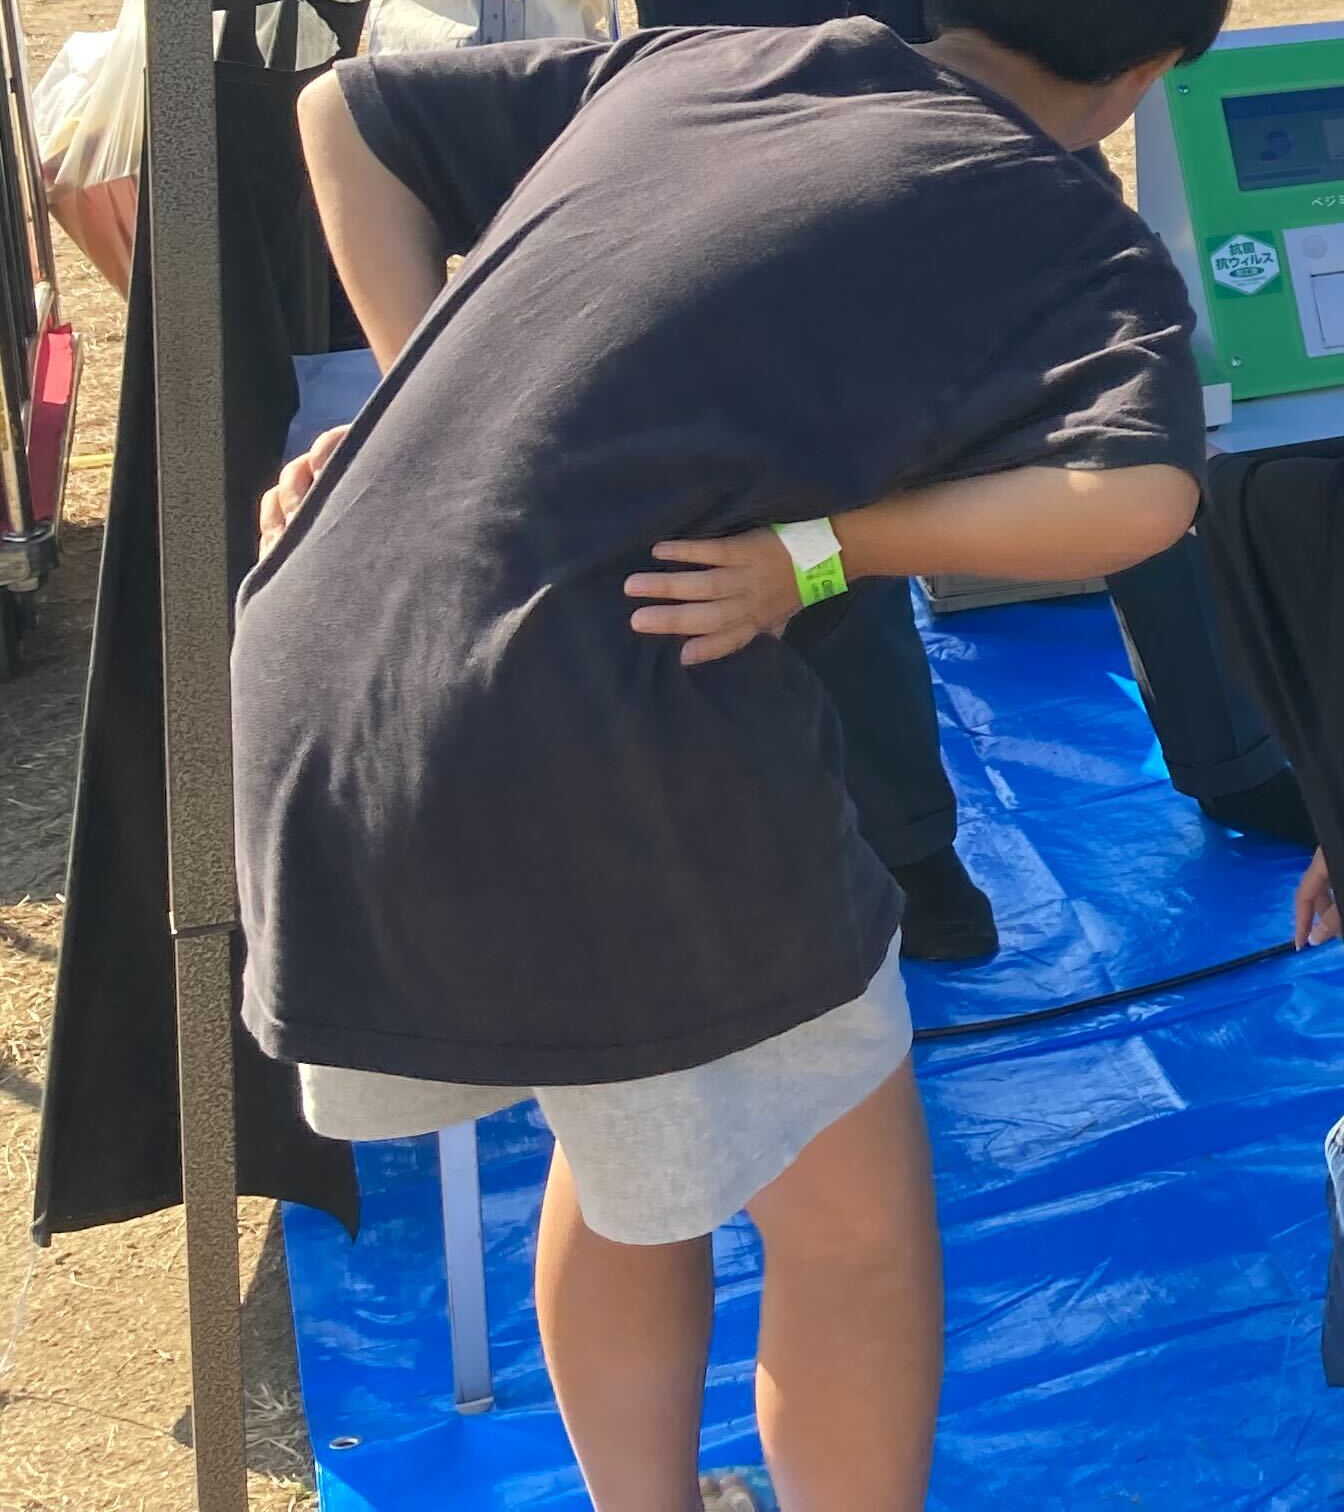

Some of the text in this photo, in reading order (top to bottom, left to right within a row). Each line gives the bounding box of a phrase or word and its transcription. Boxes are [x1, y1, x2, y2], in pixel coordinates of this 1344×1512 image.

[1228, 241, 1256, 256] 抗菌
[1215, 252, 1275, 271] 抗ウィルス
